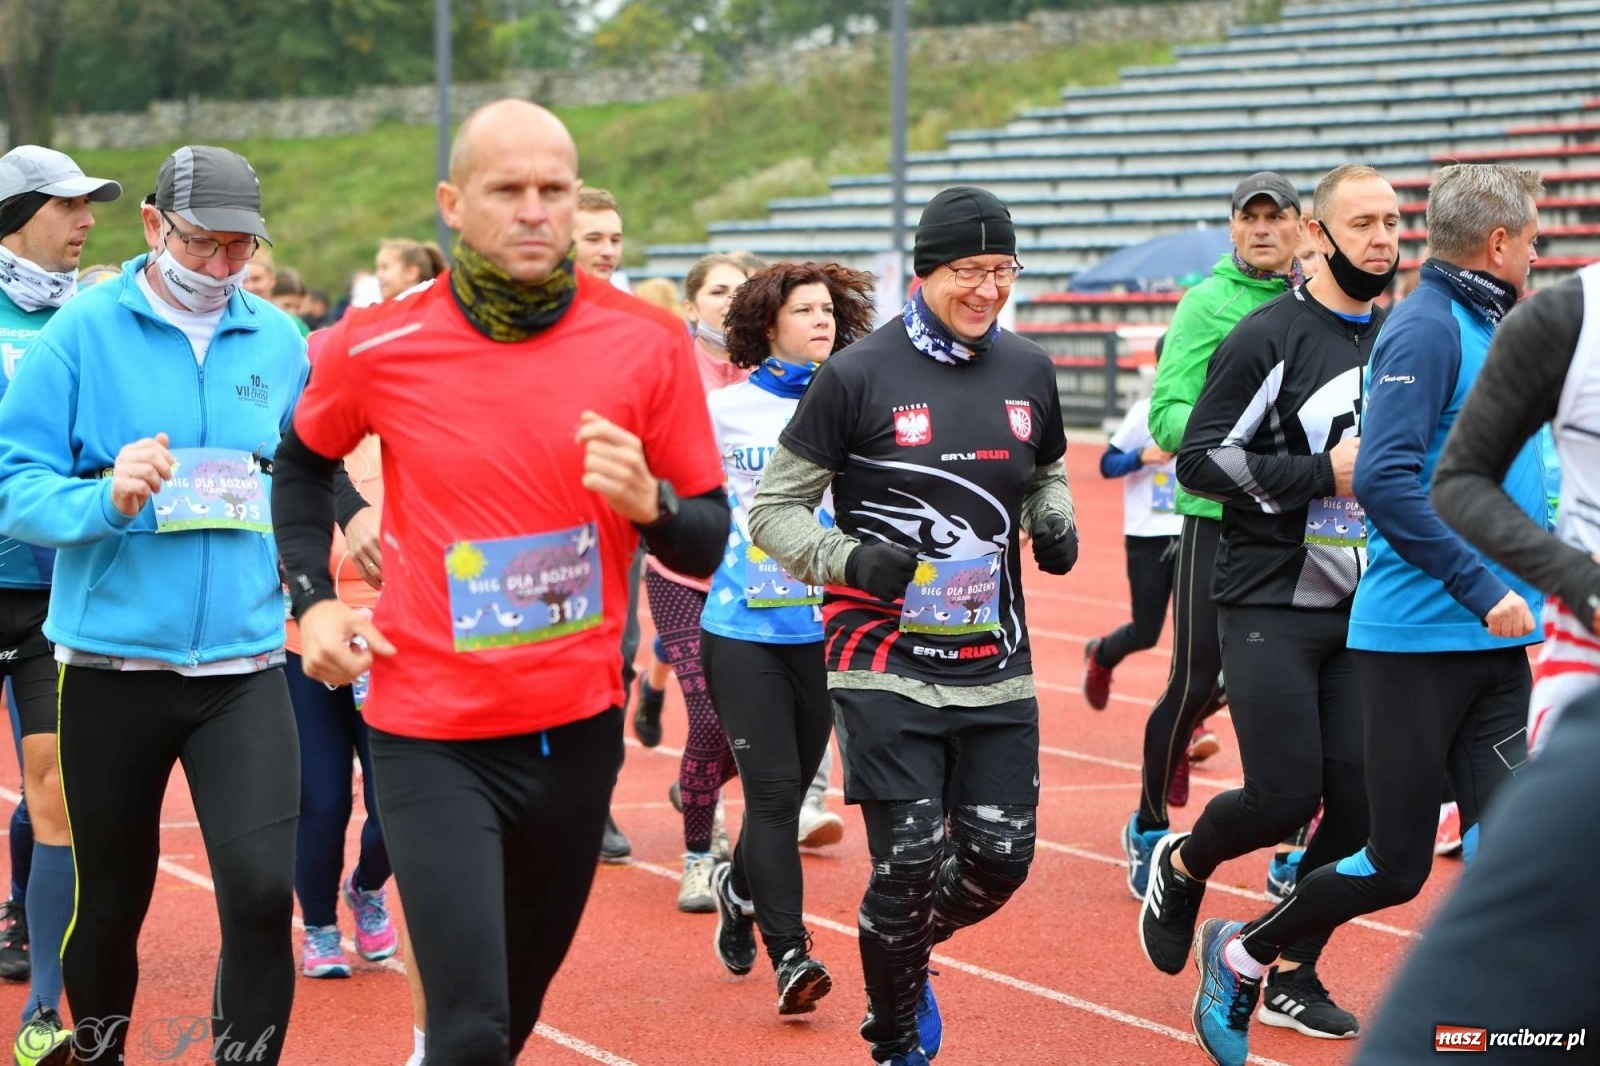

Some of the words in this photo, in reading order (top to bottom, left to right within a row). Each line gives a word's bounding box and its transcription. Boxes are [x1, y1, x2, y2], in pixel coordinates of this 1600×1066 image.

[893, 402, 928, 412] POLSKA
[224, 503, 260, 521] 295
[759, 563, 777, 572] BIEG
[921, 587, 941, 596] BIEG
[947, 587, 963, 596] DLA
[548, 596, 588, 624] 319
[962, 607, 991, 625] 279
